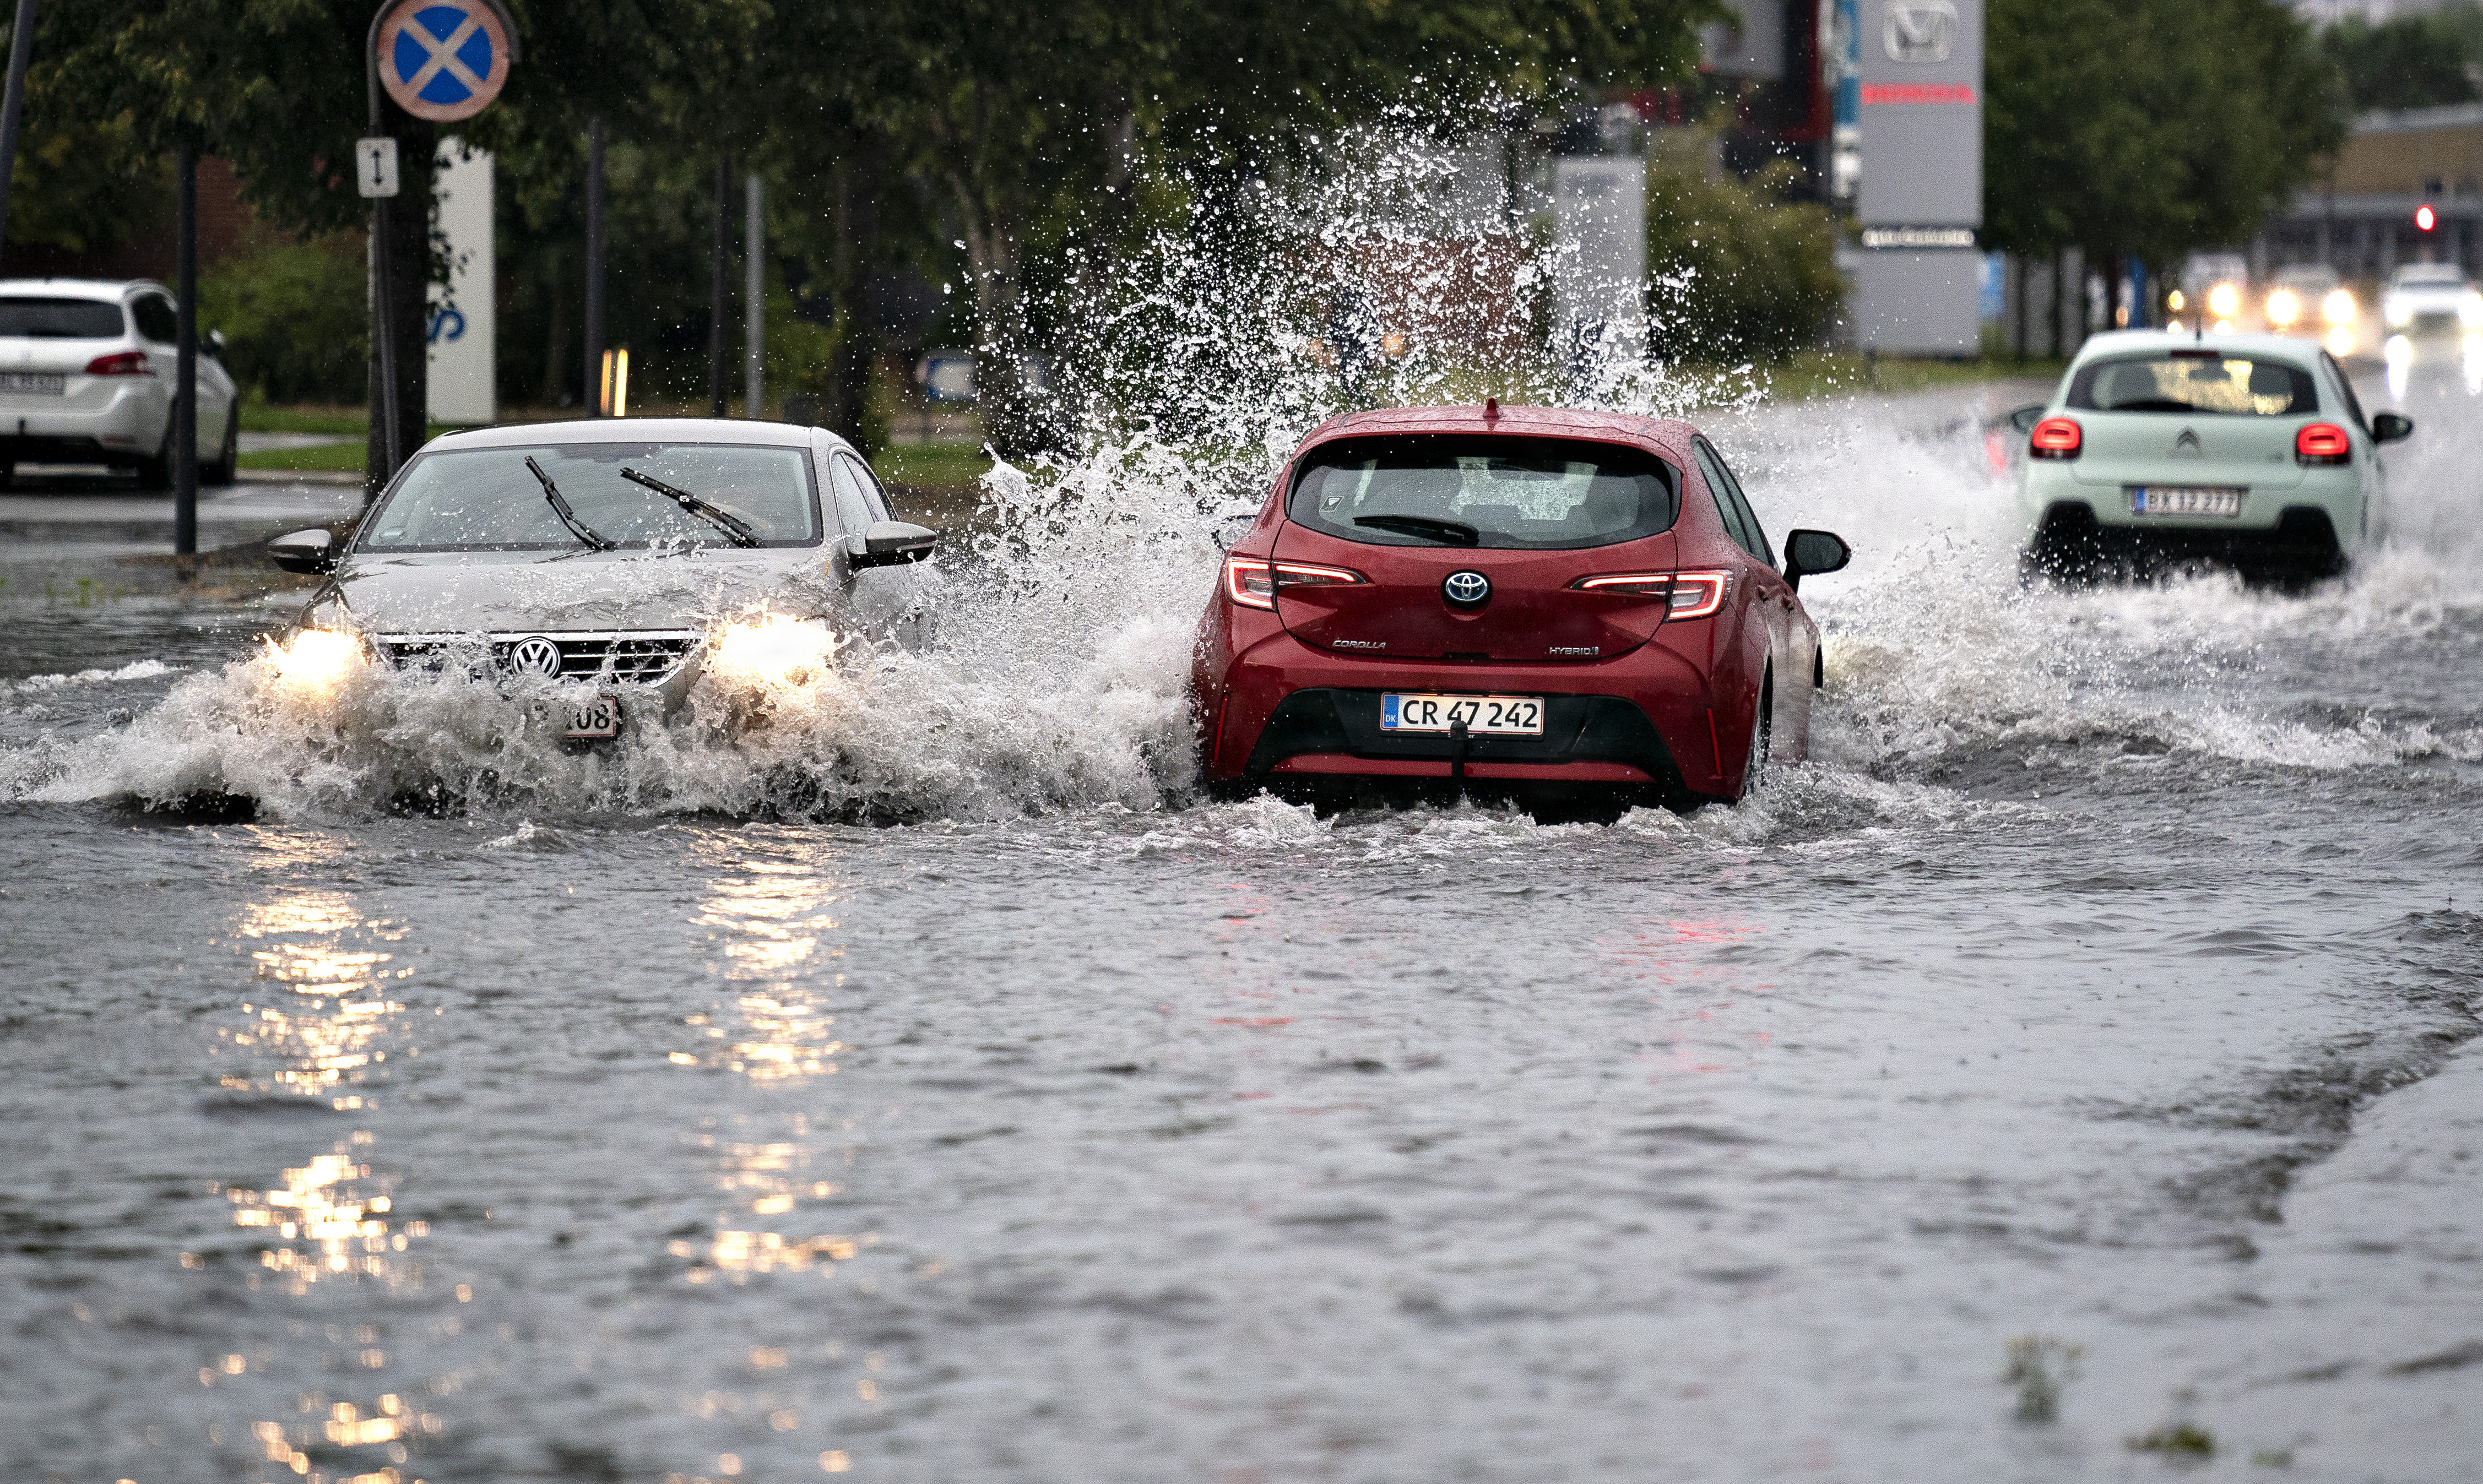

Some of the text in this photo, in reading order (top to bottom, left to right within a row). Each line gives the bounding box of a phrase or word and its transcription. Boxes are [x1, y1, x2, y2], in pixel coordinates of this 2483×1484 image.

[1332, 640, 1386, 649] COROLLA
[1549, 646, 1591, 655] HYBRID
[566, 704, 610, 730] 08
[1402, 700, 1538, 728] CR 47 242
